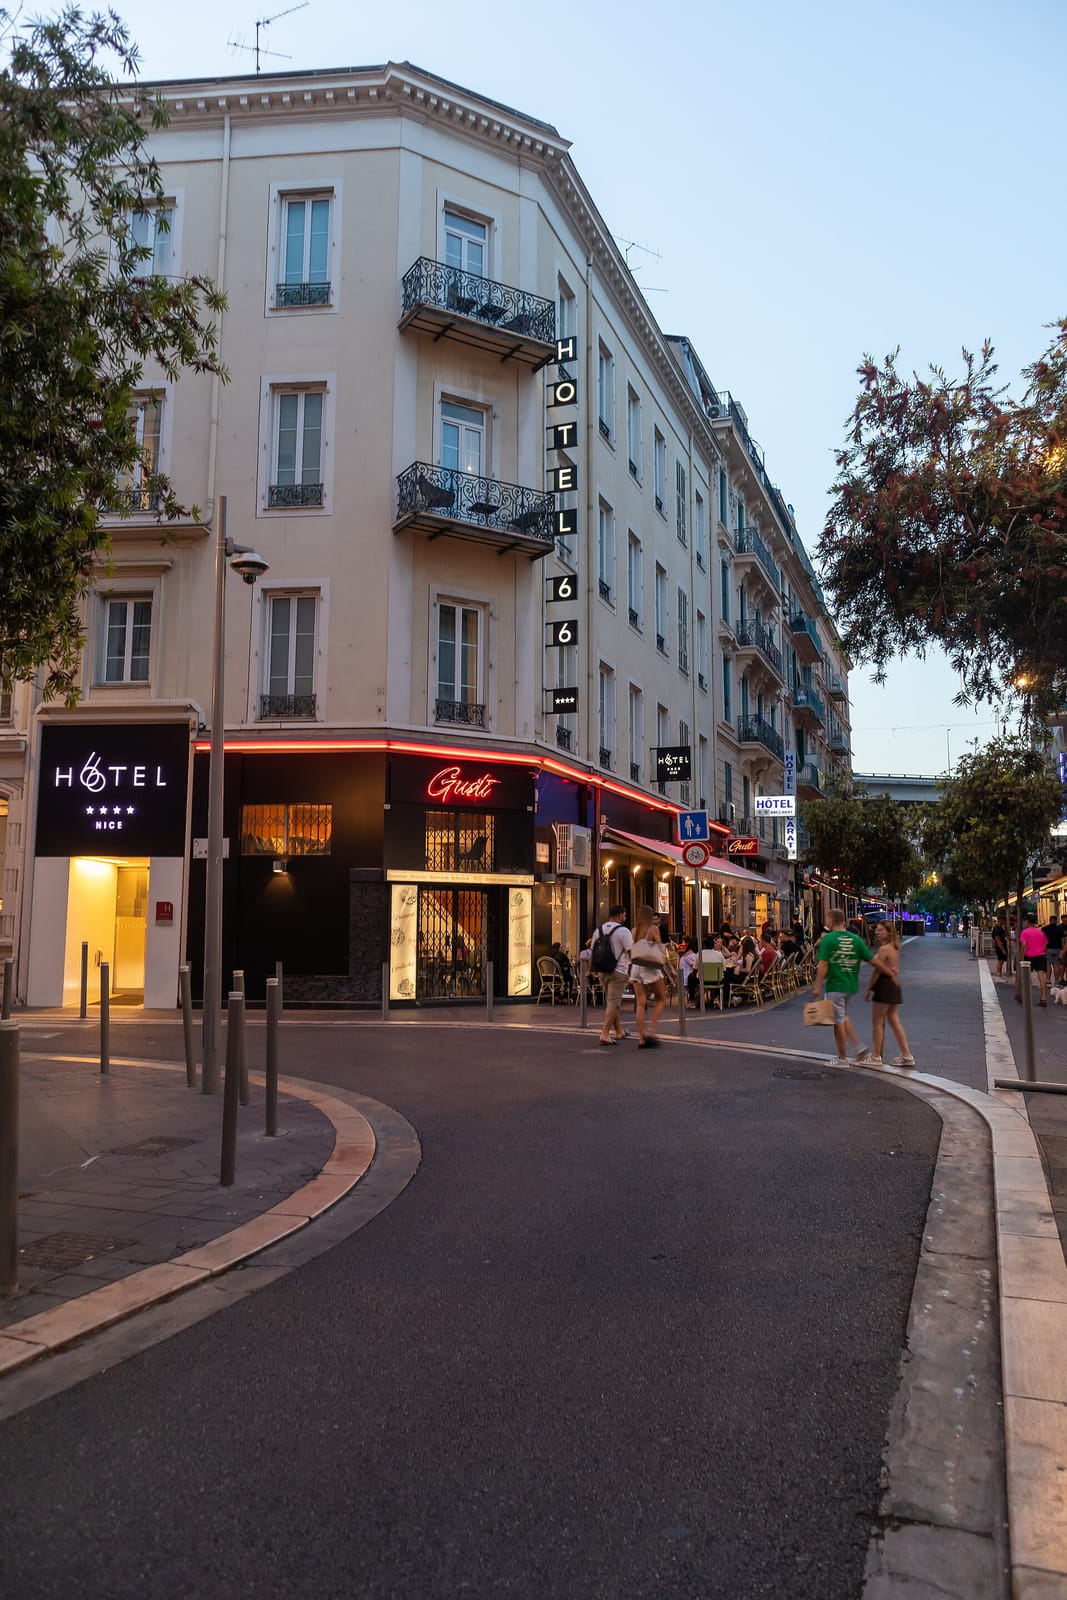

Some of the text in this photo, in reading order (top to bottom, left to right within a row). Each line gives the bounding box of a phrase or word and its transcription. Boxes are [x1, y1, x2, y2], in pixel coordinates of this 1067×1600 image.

[555, 340, 575, 533] HOTEL
[427, 766, 502, 802] Gusti
[756, 797, 793, 809] HÔTEL
[95, 821, 123, 830] NICE
[729, 840, 757, 853] Gusti
